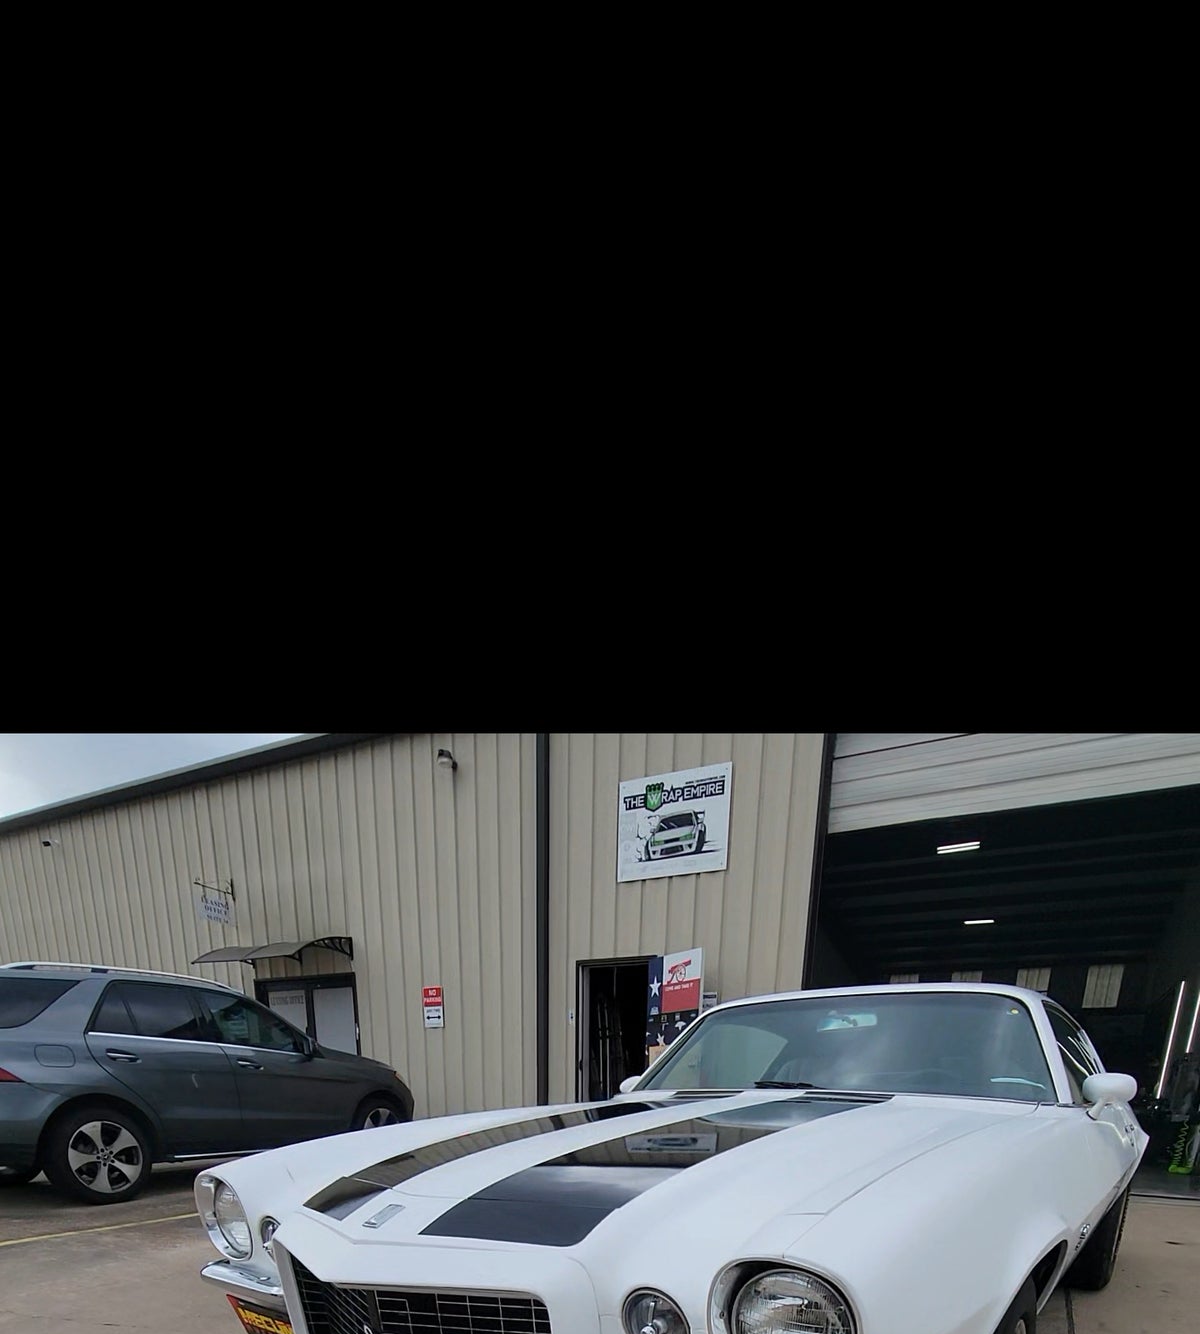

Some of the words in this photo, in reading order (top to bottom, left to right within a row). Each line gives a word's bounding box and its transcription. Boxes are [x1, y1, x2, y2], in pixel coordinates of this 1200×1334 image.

[625, 795, 645, 808] THE
[647, 788, 682, 804] WRAP
[683, 782, 723, 799] EMPIRE
